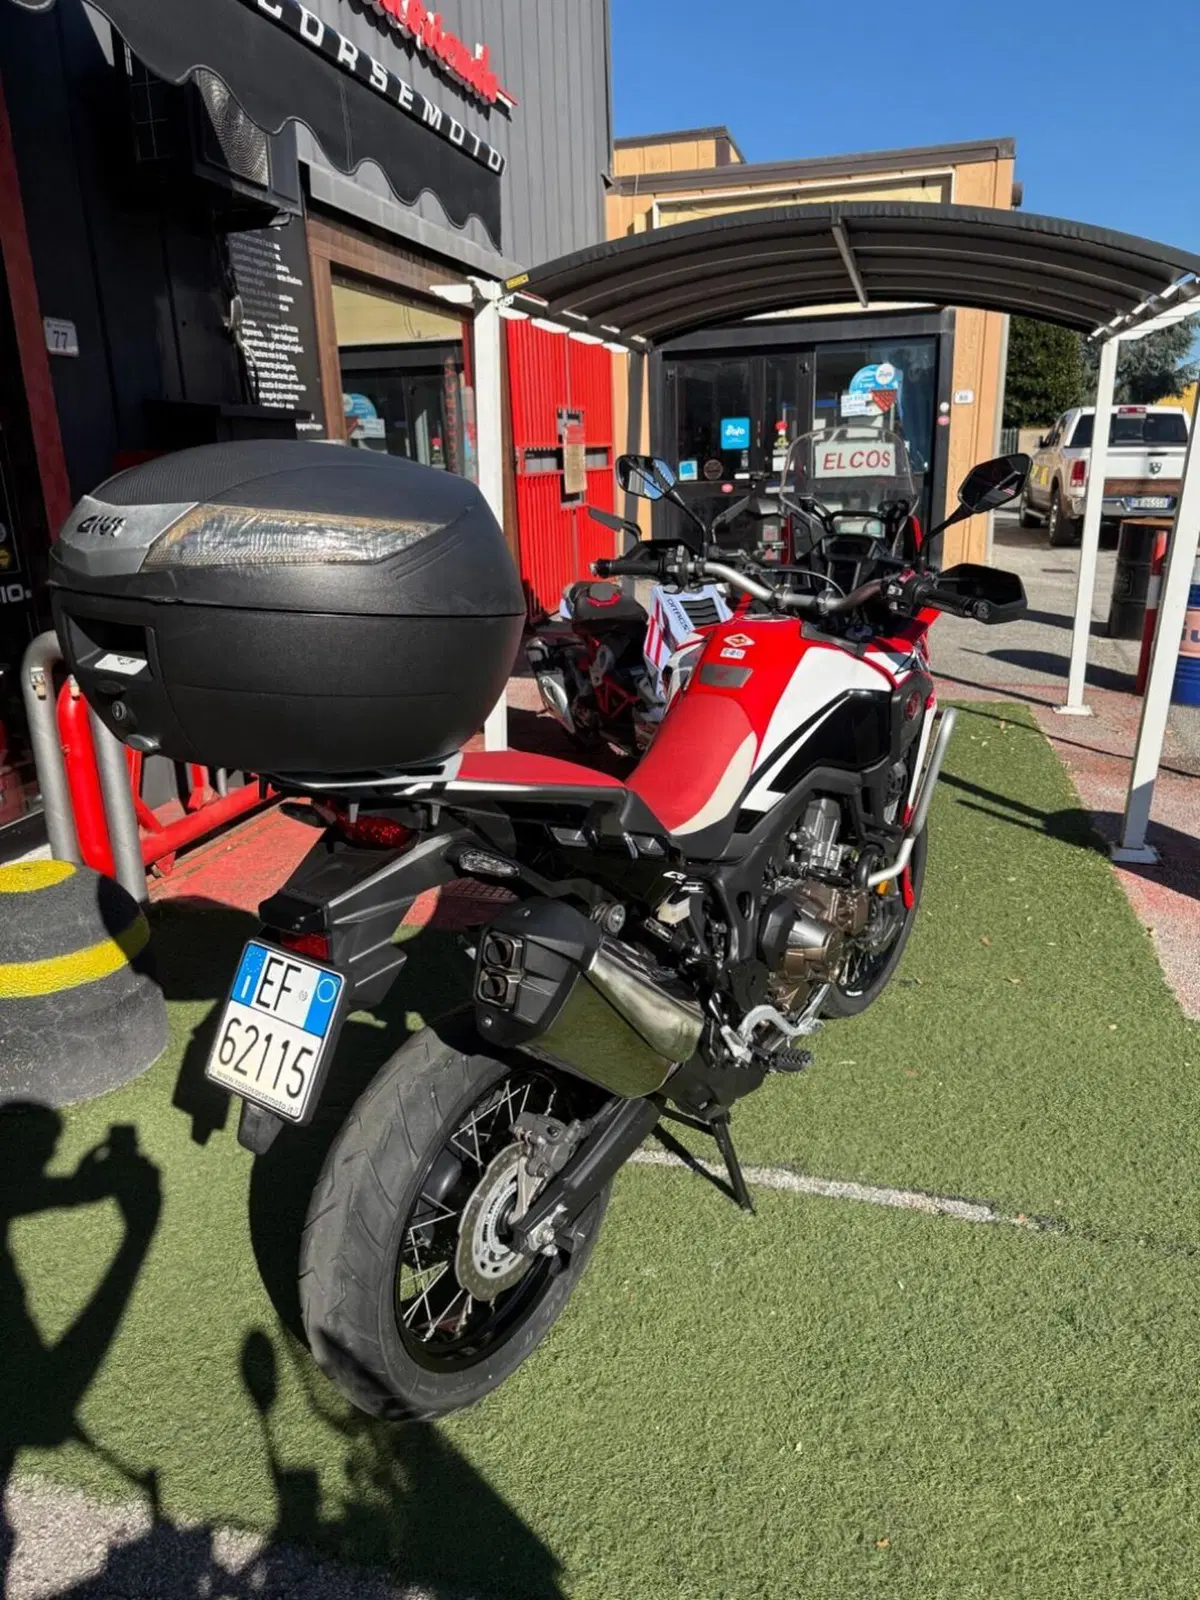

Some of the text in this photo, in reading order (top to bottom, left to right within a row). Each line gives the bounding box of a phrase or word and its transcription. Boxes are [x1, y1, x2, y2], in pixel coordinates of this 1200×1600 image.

[53, 330, 69, 349] 77
[822, 449, 891, 471] ELCOS
[255, 956, 302, 1011] EF
[217, 1017, 314, 1099] 62115
